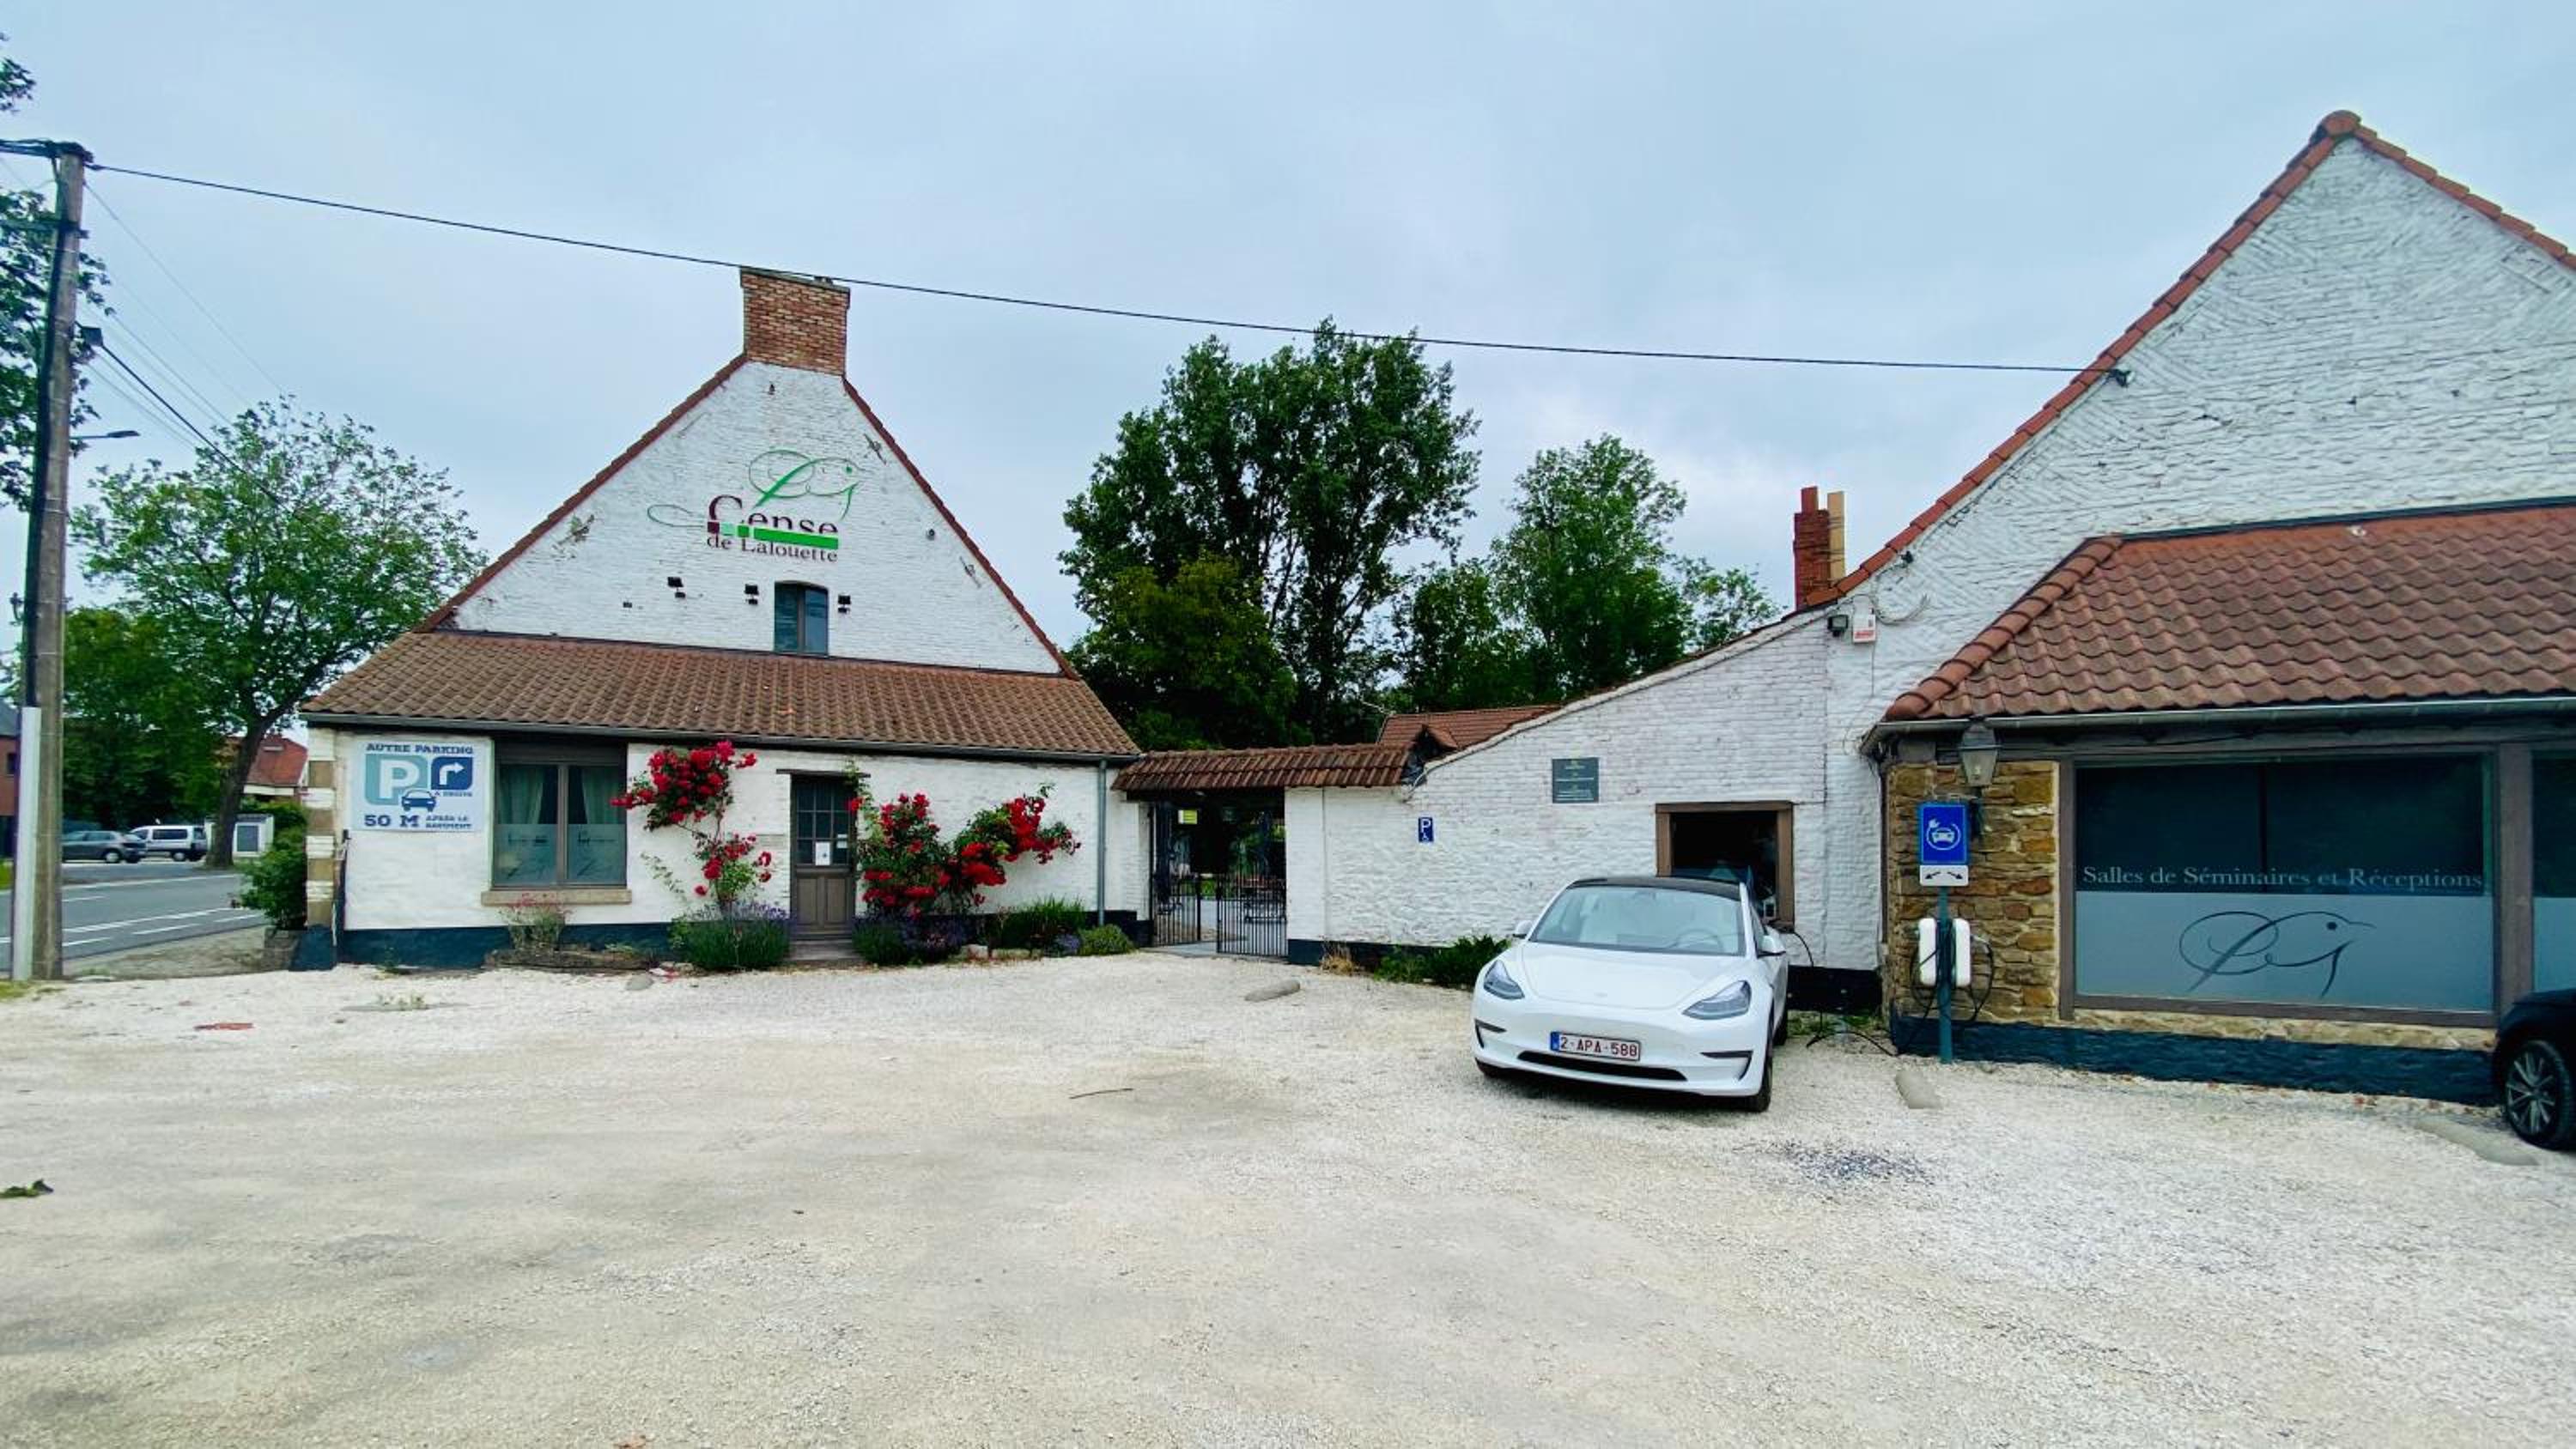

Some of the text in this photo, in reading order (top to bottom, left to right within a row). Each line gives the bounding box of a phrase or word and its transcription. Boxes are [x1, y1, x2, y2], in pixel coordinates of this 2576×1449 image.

[707, 534, 838, 562] de Lalouette
[366, 743, 473, 754] AUTRE PARKING
[379, 761, 419, 799] P
[364, 815, 419, 828] 50 M
[1421, 818, 1431, 833] P
[2083, 866, 2482, 892] Salles de Séminaires et Réceptions
